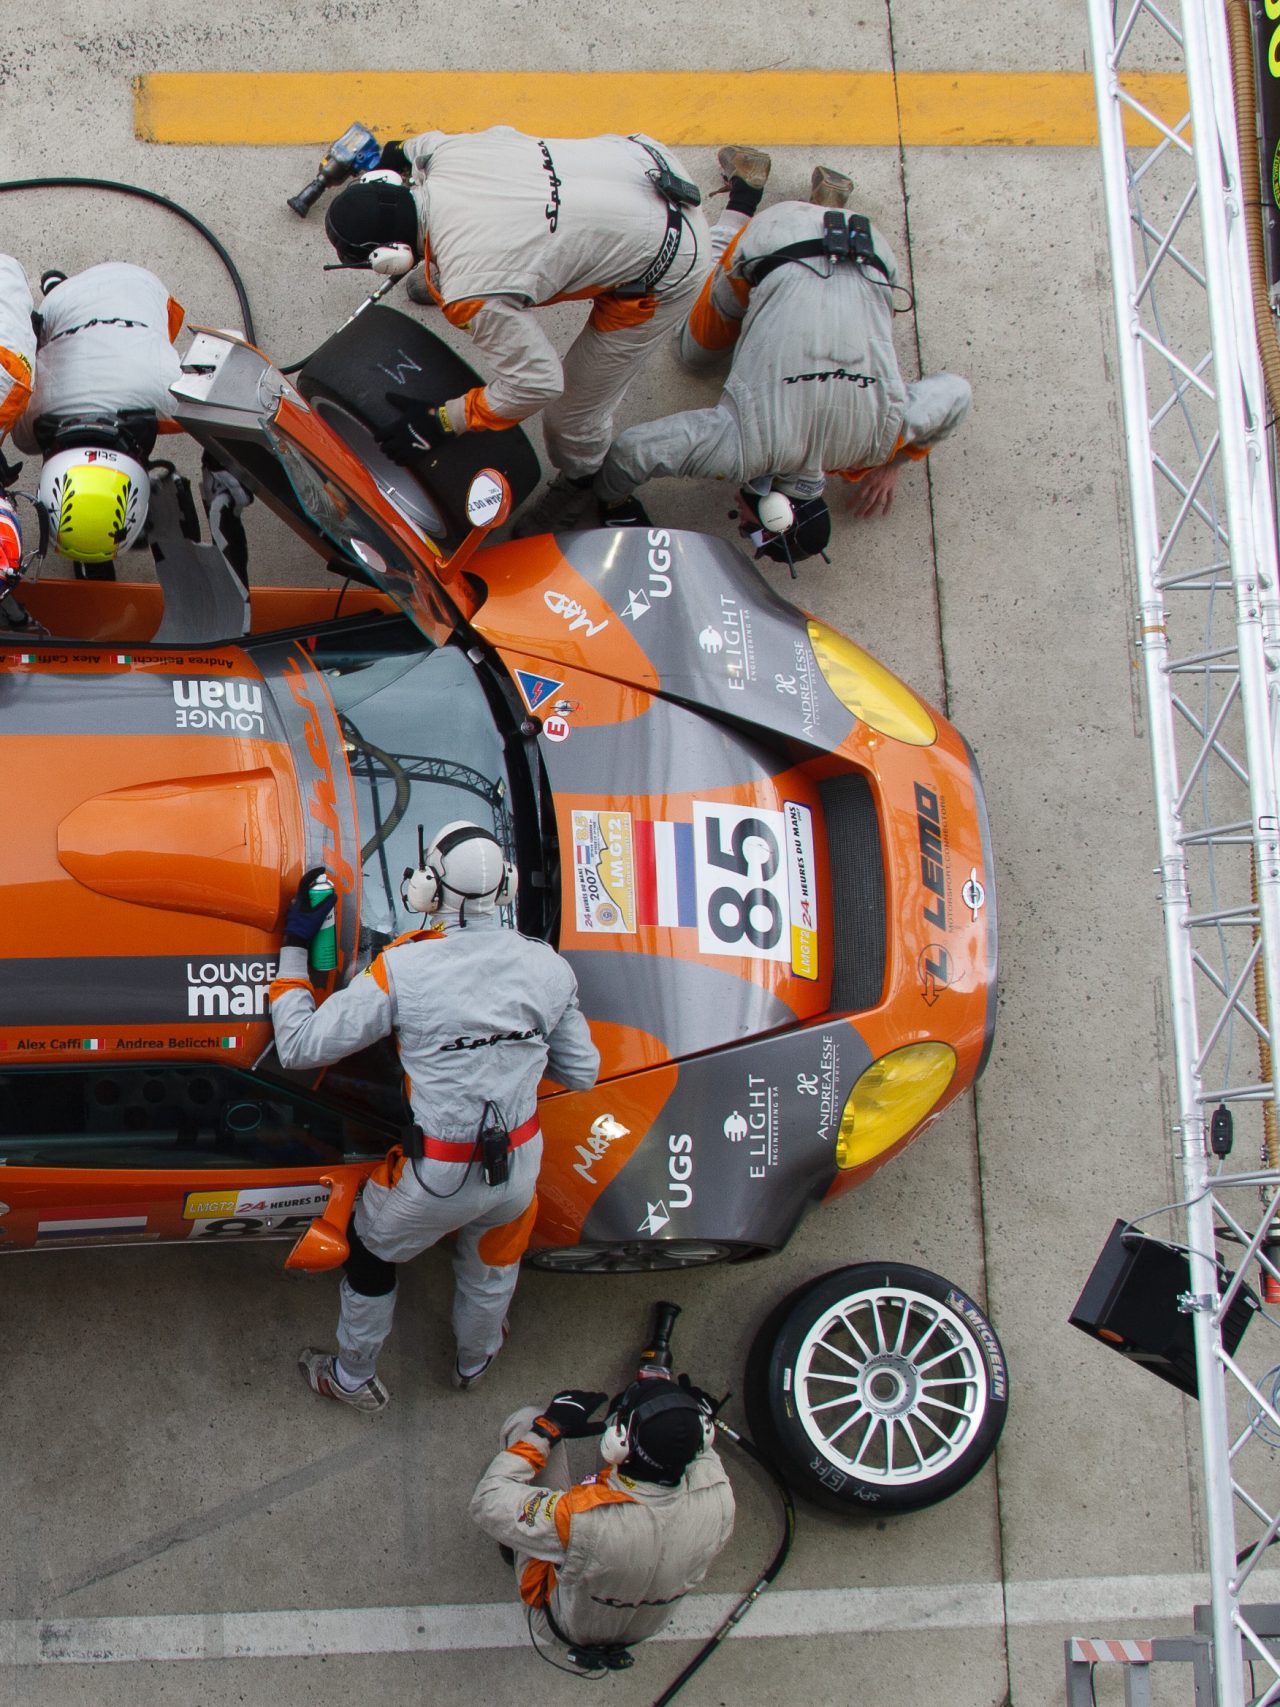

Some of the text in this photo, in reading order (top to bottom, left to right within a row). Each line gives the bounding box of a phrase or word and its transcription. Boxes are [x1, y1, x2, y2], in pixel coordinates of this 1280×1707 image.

[537, 140, 561, 233] Spyker
[783, 368, 876, 389] Spyker
[648, 529, 672, 598] UGS
[721, 594, 745, 691] E-LIGHT
[38, 654, 101, 664] Alex Caffi
[188, 655, 234, 669] Andrea
[173, 680, 263, 714] man
[175, 709, 265, 734] LOUNGE
[575, 815, 589, 841] 85
[789, 806, 800, 838] MANS
[794, 840, 803, 856] DU
[913, 781, 947, 932] LEMO
[584, 868, 601, 901] 2007
[705, 816, 783, 950] 85
[798, 856, 808, 897] HEURES
[800, 900, 813, 929] 24
[186, 962, 276, 983] LOUNGE
[17, 1038, 81, 1050] Alex Caffi
[116, 1036, 220, 1049] Andrea Belicchi
[439, 1026, 545, 1051] Spyker
[817, 1035, 833, 1141] ANDREAESSE
[748, 1074, 766, 1155] LIGHT
[772, 1085, 780, 1166] ENGINEERING SA
[669, 1133, 693, 1209] UGS
[235, 1200, 269, 1213] 24
[270, 1198, 311, 1209] HEURES
[964, 1308, 1006, 1398] MICHELIN
